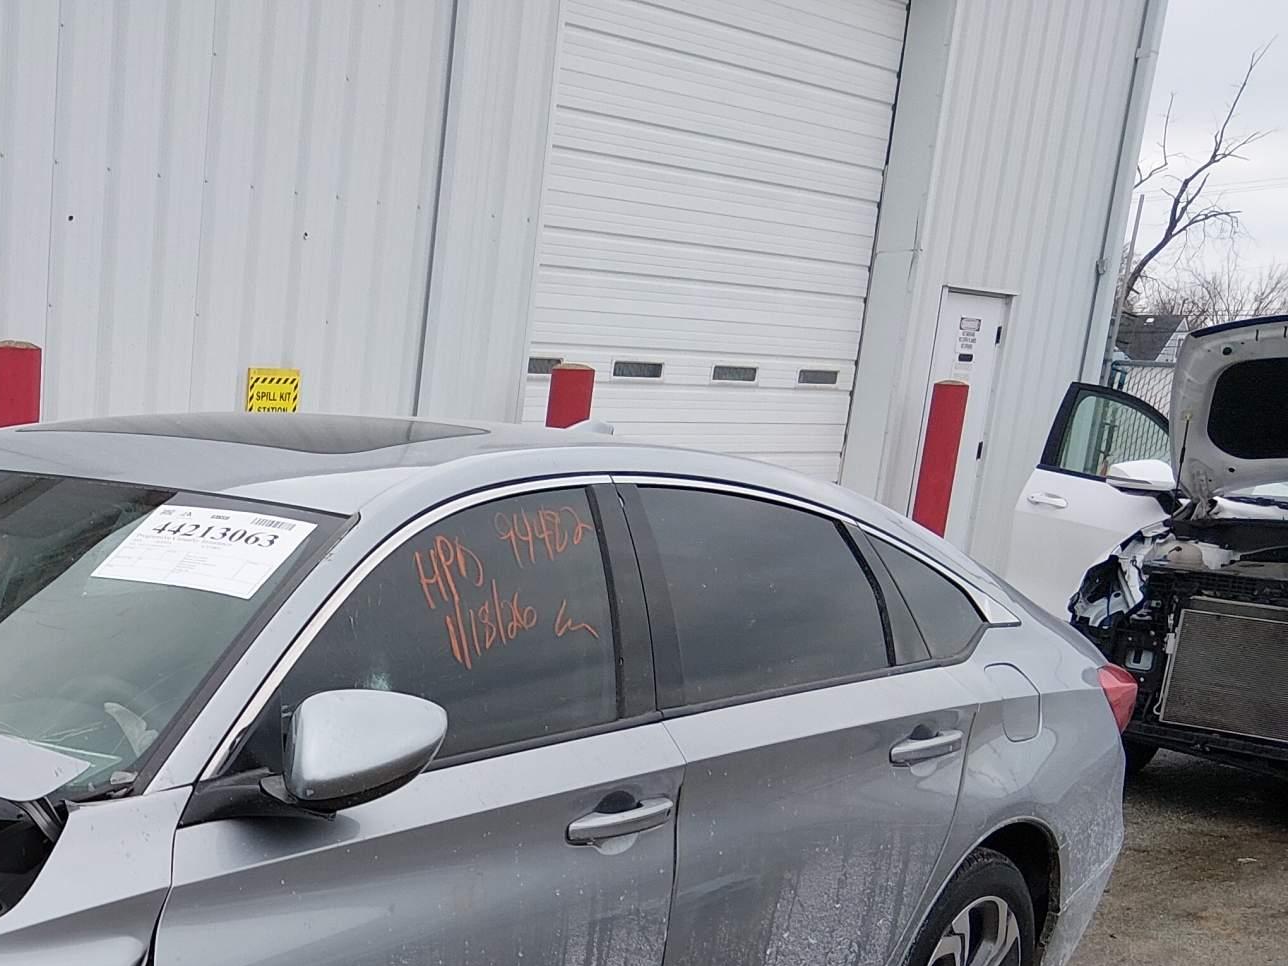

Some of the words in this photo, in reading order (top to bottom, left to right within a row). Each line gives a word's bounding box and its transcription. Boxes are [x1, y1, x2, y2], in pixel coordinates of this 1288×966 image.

[255, 391, 277, 402] SPILL
[279, 391, 292, 402] KIT
[151, 521, 280, 548] 44213063
